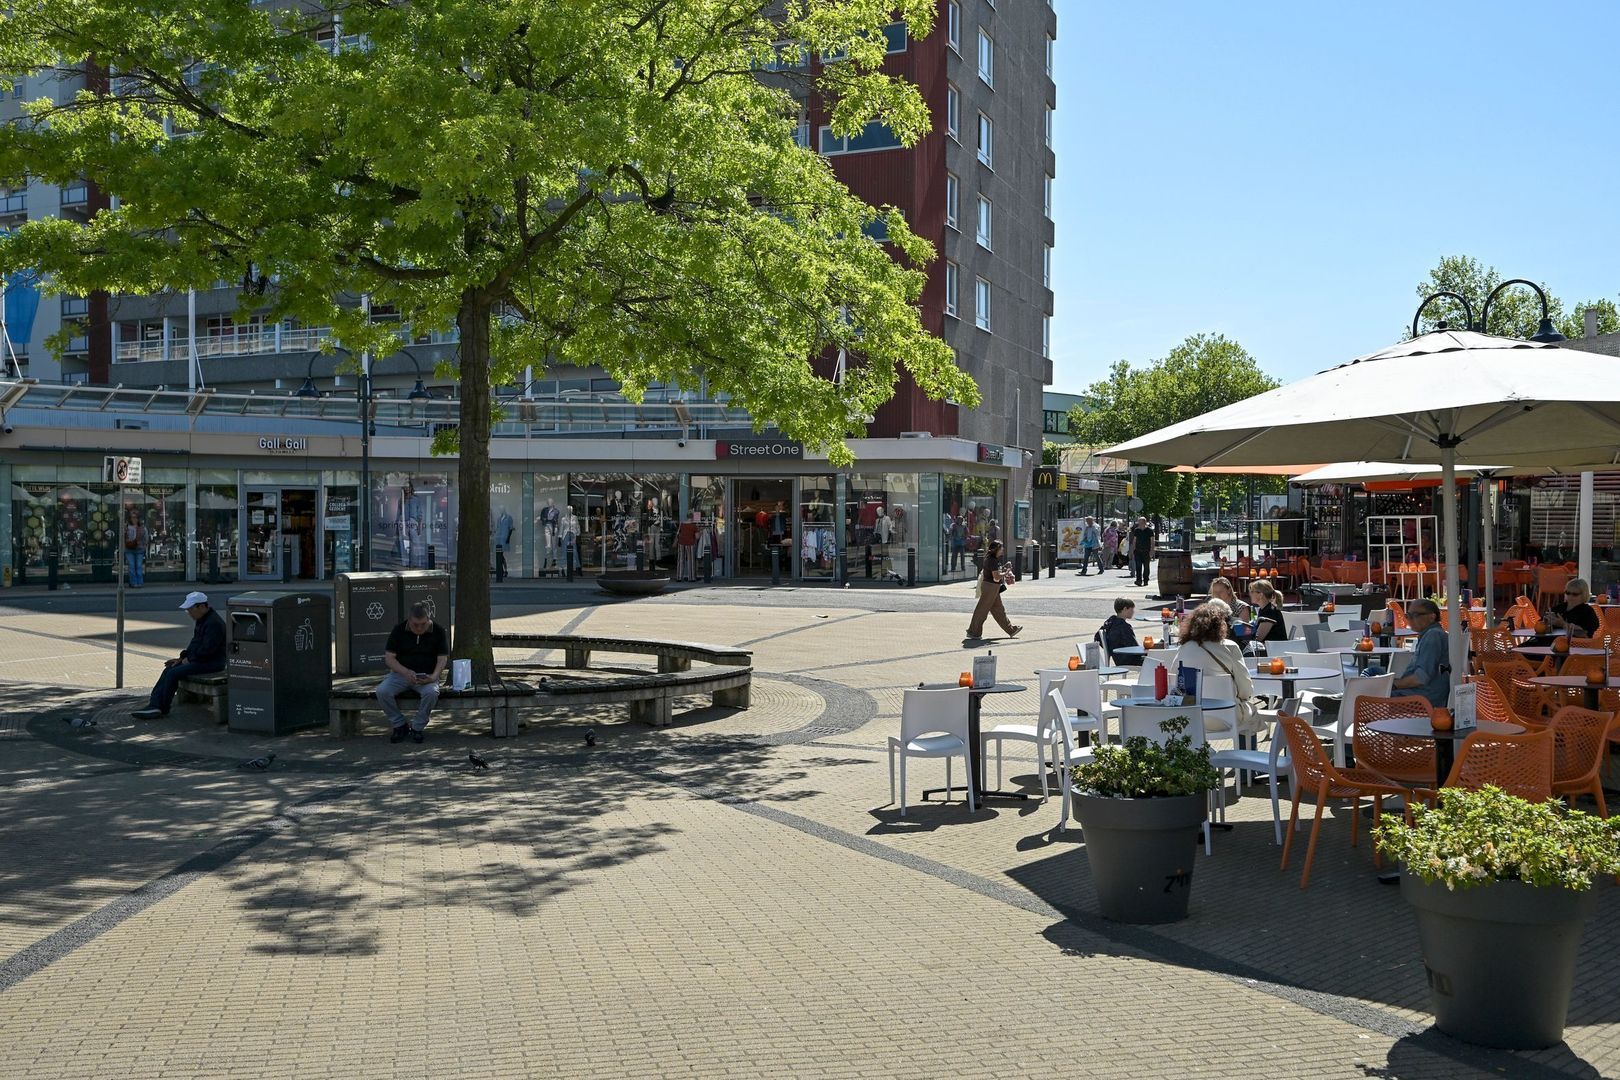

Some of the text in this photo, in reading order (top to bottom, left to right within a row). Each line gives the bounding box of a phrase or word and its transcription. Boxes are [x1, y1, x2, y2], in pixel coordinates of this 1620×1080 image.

[259, 437, 280, 449] Gall
[285, 437, 306, 449] Gall
[730, 443, 800, 455] Street One
